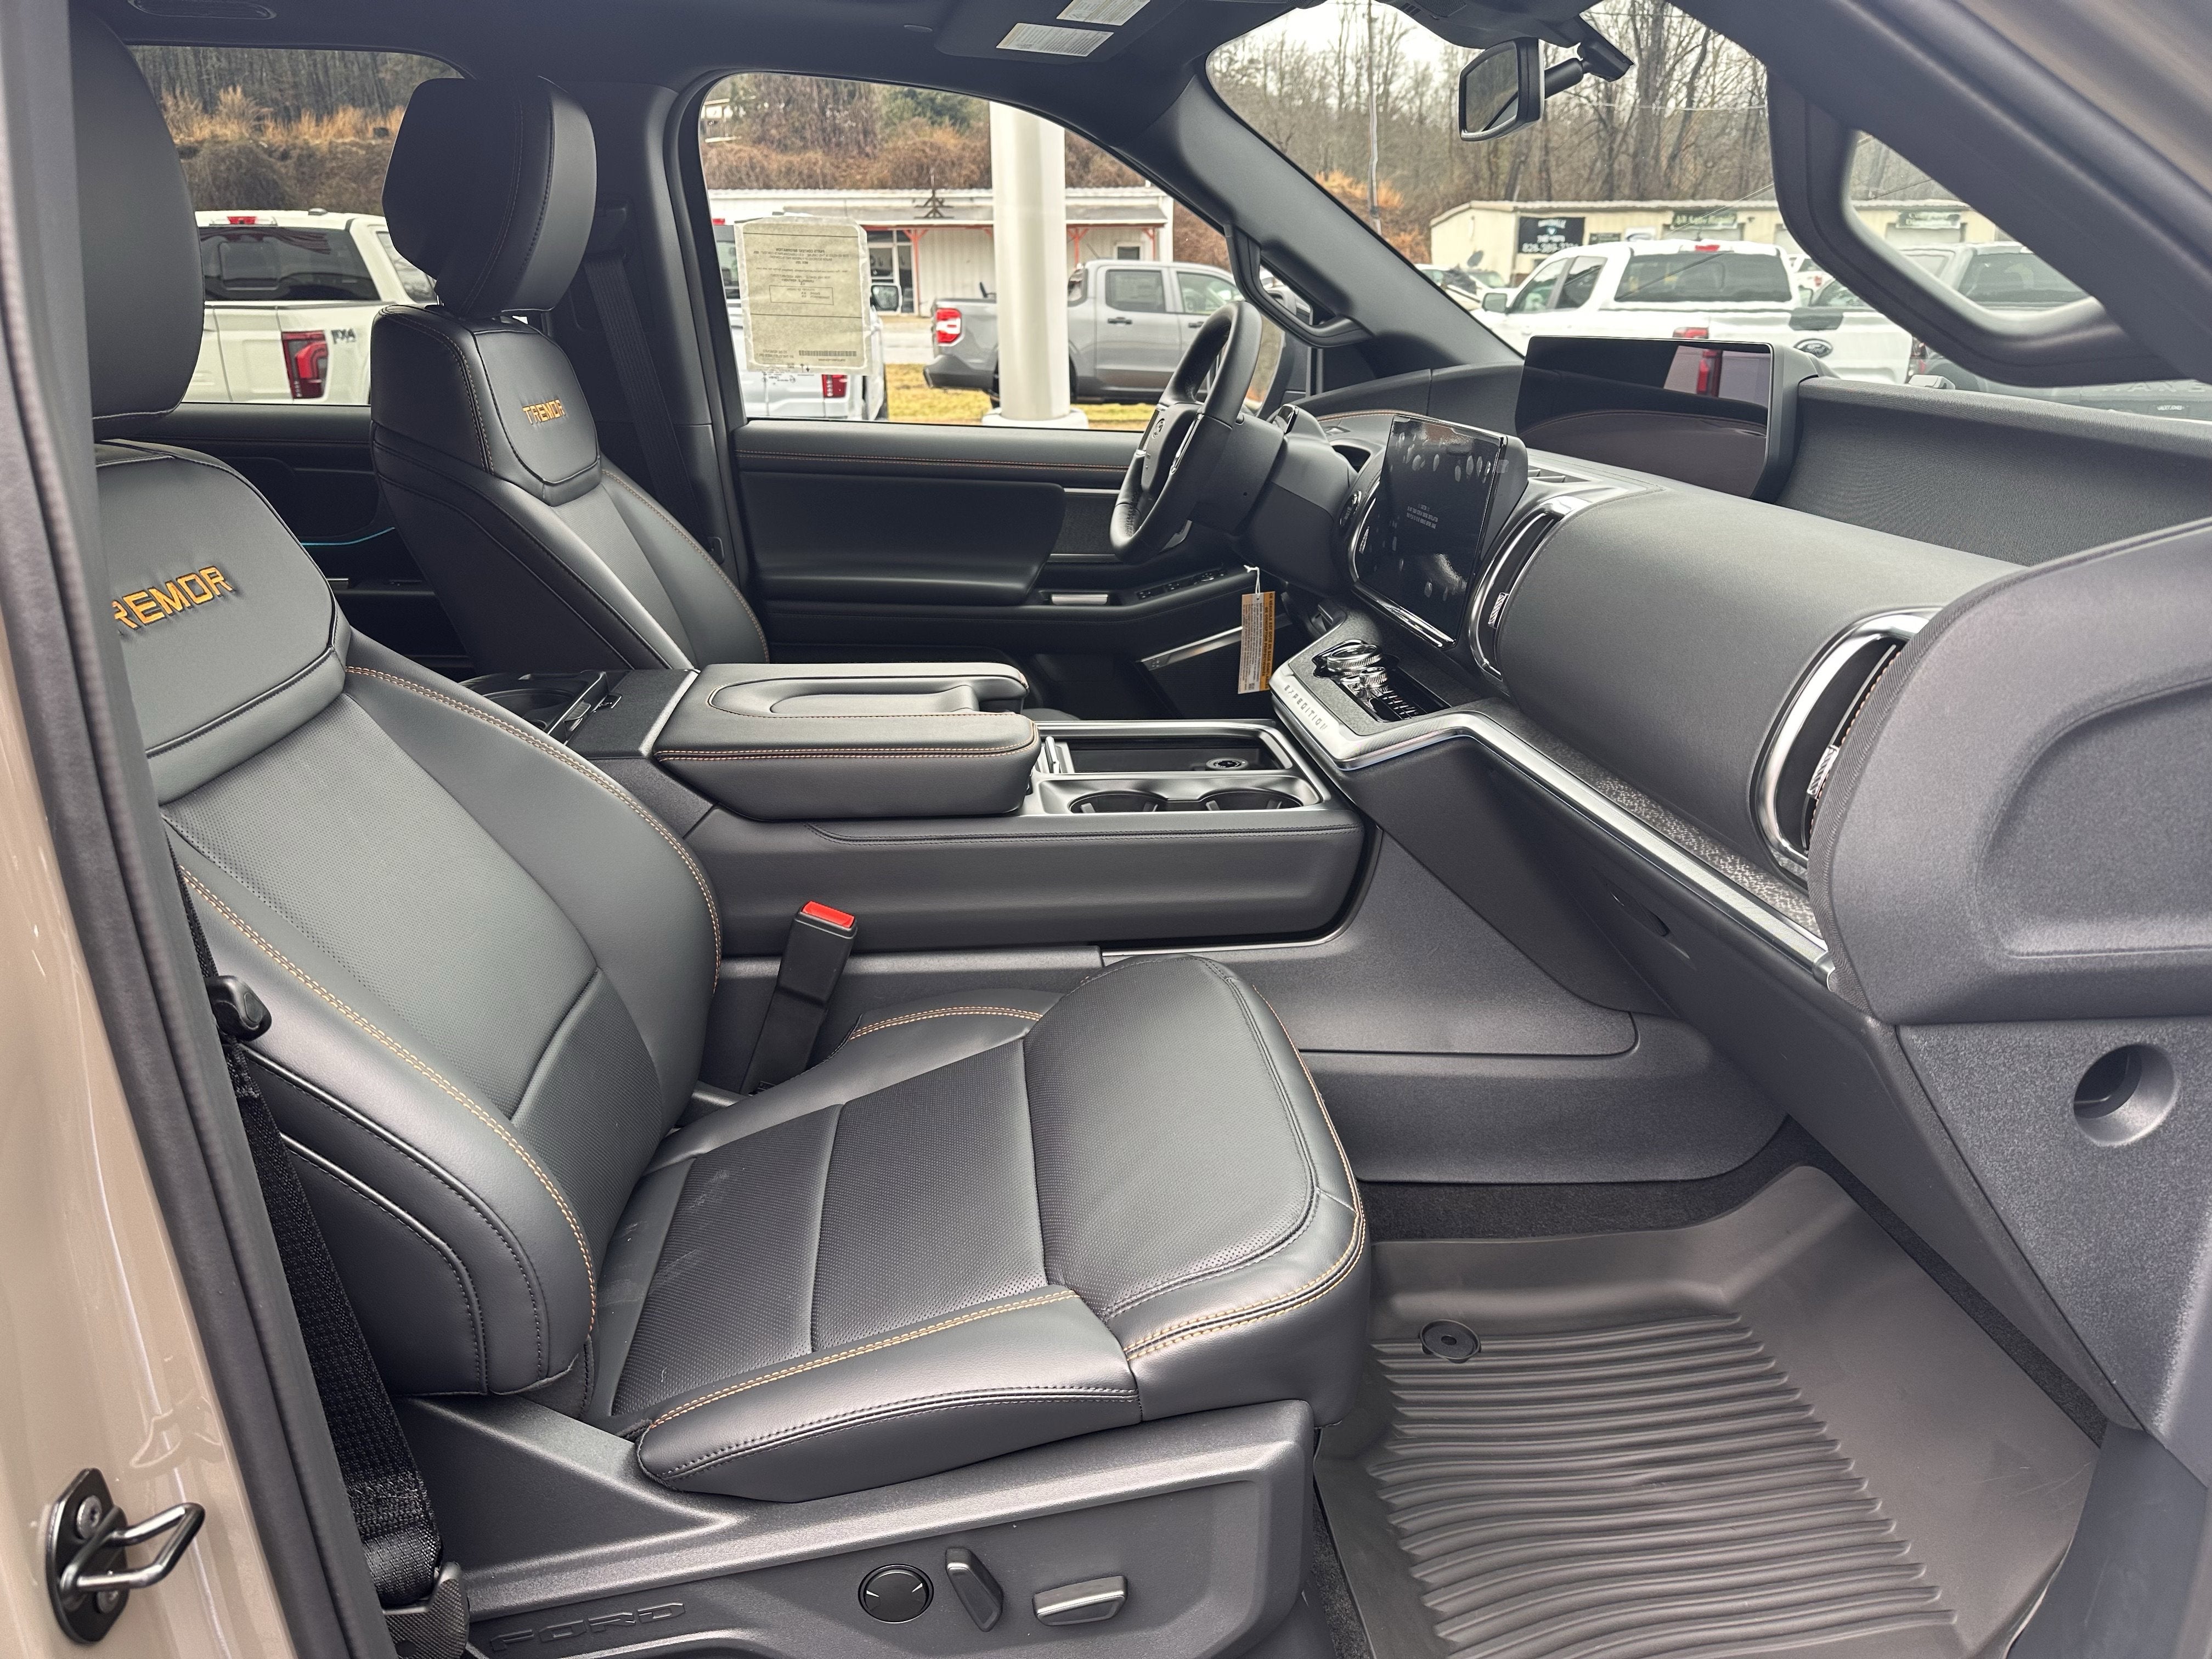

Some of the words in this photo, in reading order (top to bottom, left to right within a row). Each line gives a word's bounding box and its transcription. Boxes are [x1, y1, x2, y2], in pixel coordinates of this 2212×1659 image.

[522, 399, 566, 425] TREMOR
[111, 566, 236, 631] REMOR
[1284, 685, 1328, 730] EXPEDITION
[490, 1602, 685, 1651] FORD
